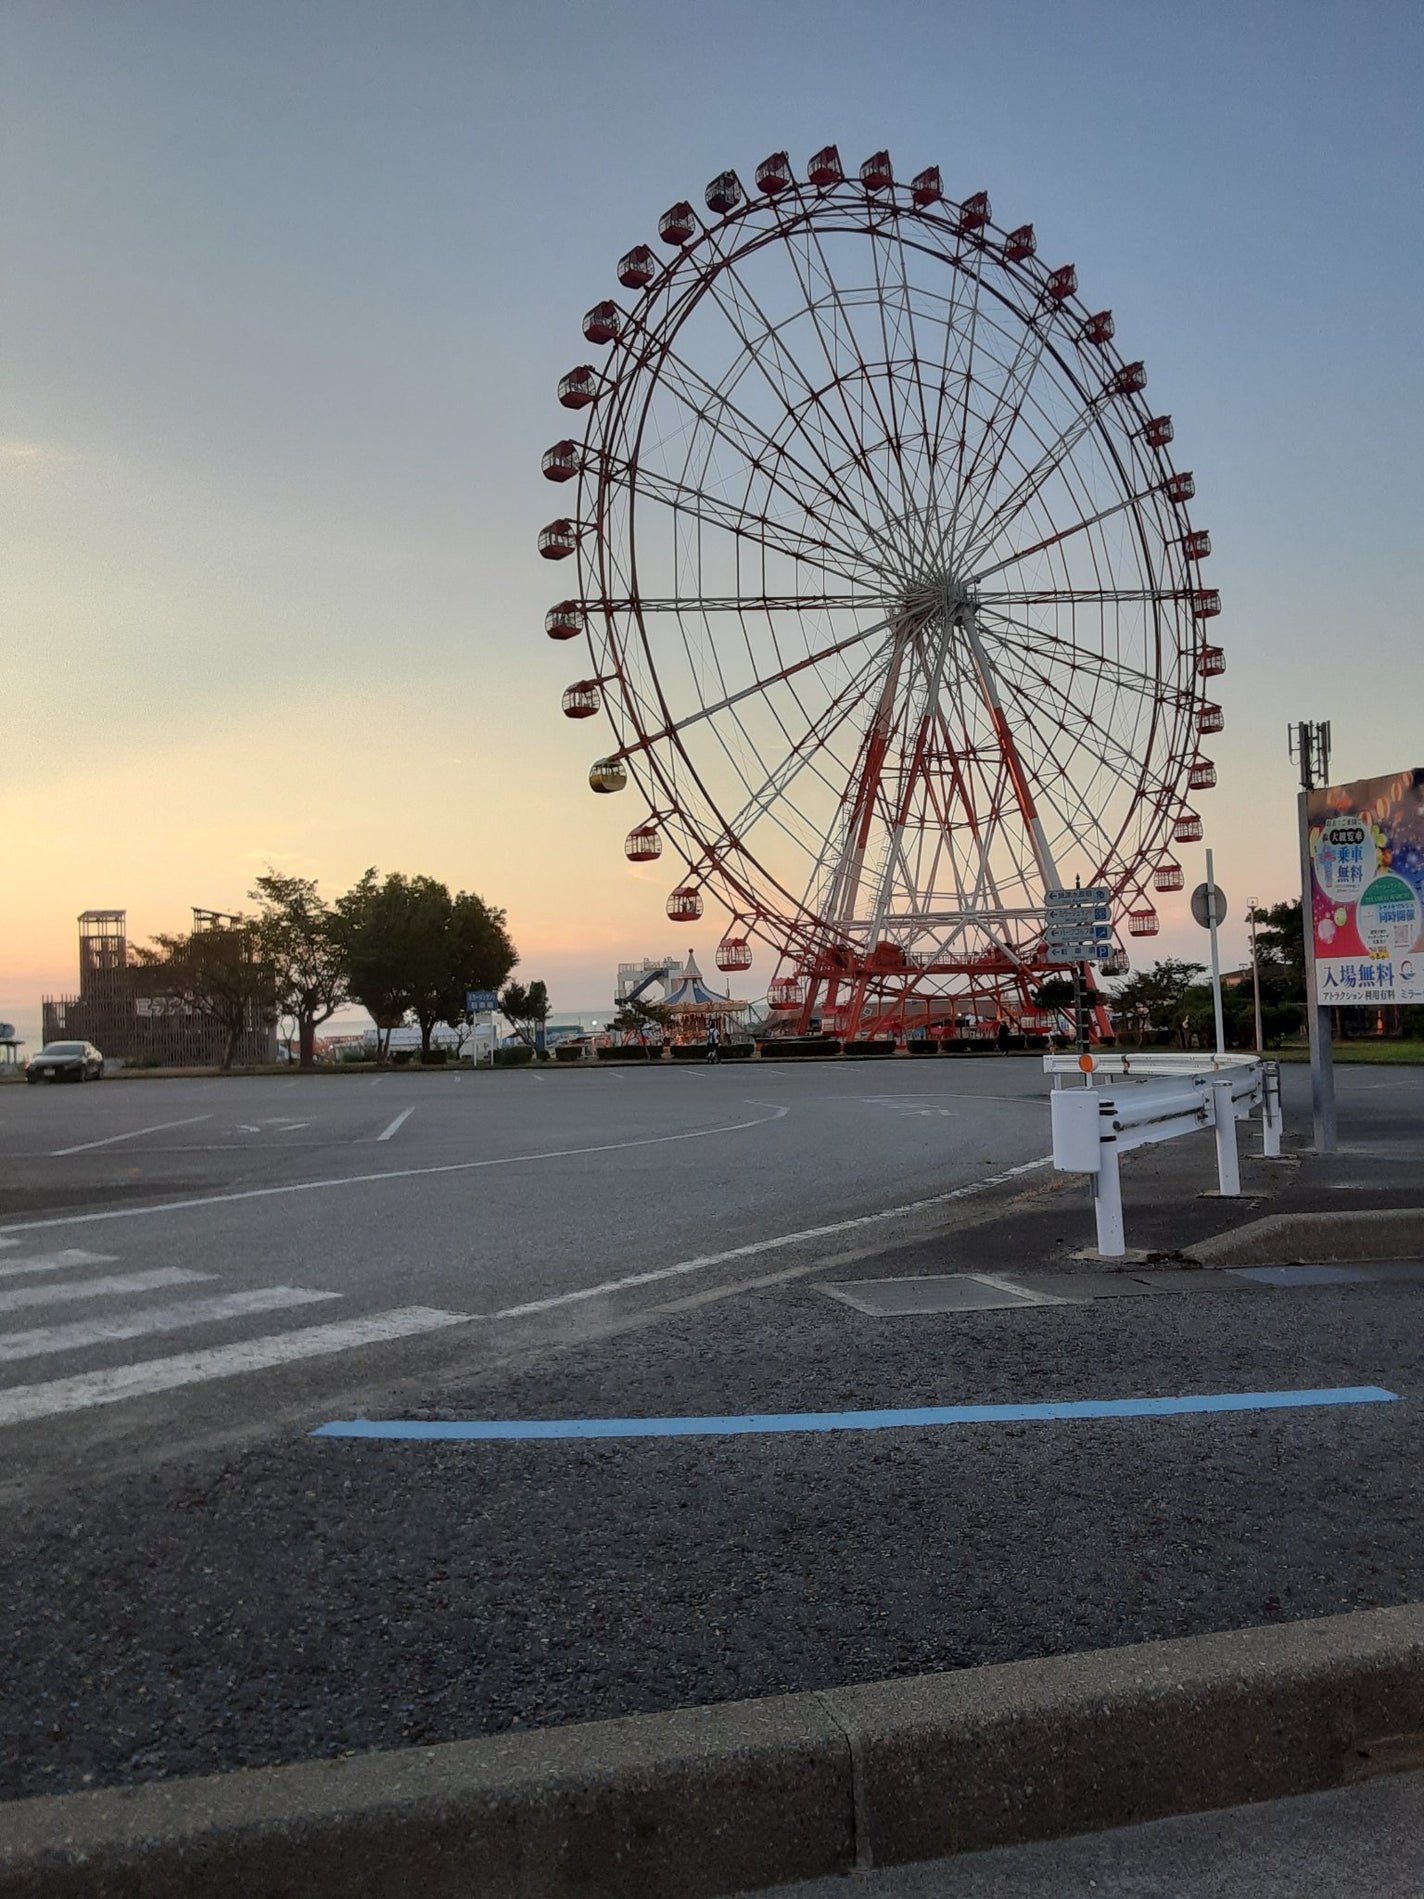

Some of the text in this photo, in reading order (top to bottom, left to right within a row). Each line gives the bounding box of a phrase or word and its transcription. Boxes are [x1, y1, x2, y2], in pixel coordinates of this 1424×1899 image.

[1332, 829, 1363, 842] 大観覧車
[1338, 846, 1363, 863] 乗車
[1337, 865, 1363, 883] 無料
[1379, 910, 1416, 924] 同時開催
[1322, 962, 1394, 988] 入場無料
[1322, 989, 1395, 1001] アトラクション利用有料
[1400, 988, 1424, 999] ミラー
